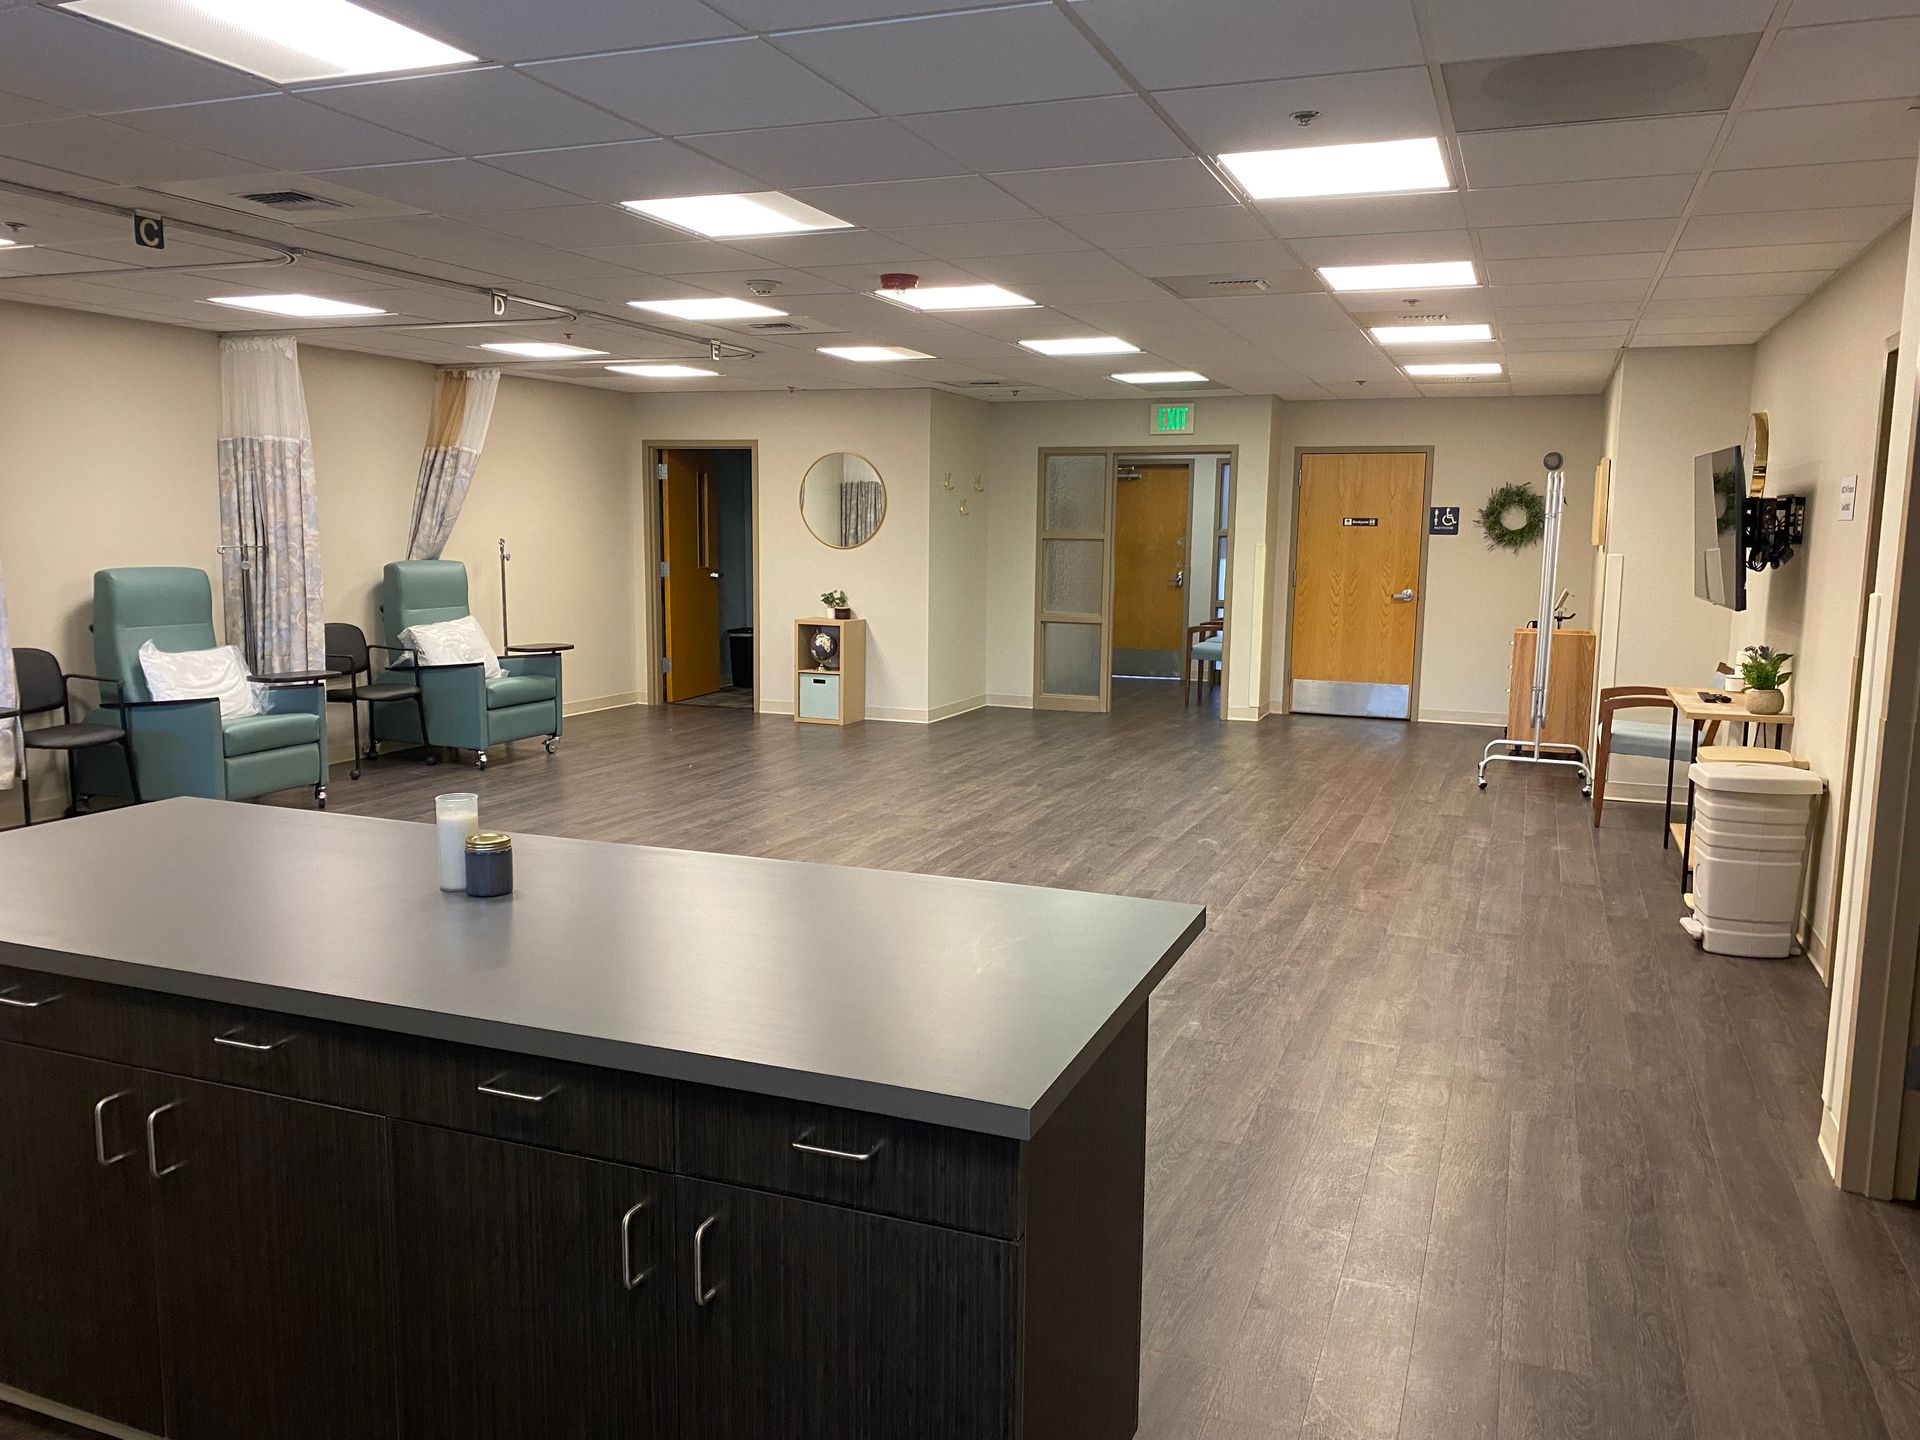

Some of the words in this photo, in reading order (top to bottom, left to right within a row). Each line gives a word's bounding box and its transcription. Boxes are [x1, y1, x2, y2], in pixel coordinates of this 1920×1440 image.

[140, 218, 160, 247] C
[494, 295, 505, 316] D
[712, 345, 720, 361] E
[1157, 407, 1189, 431] EXIT
